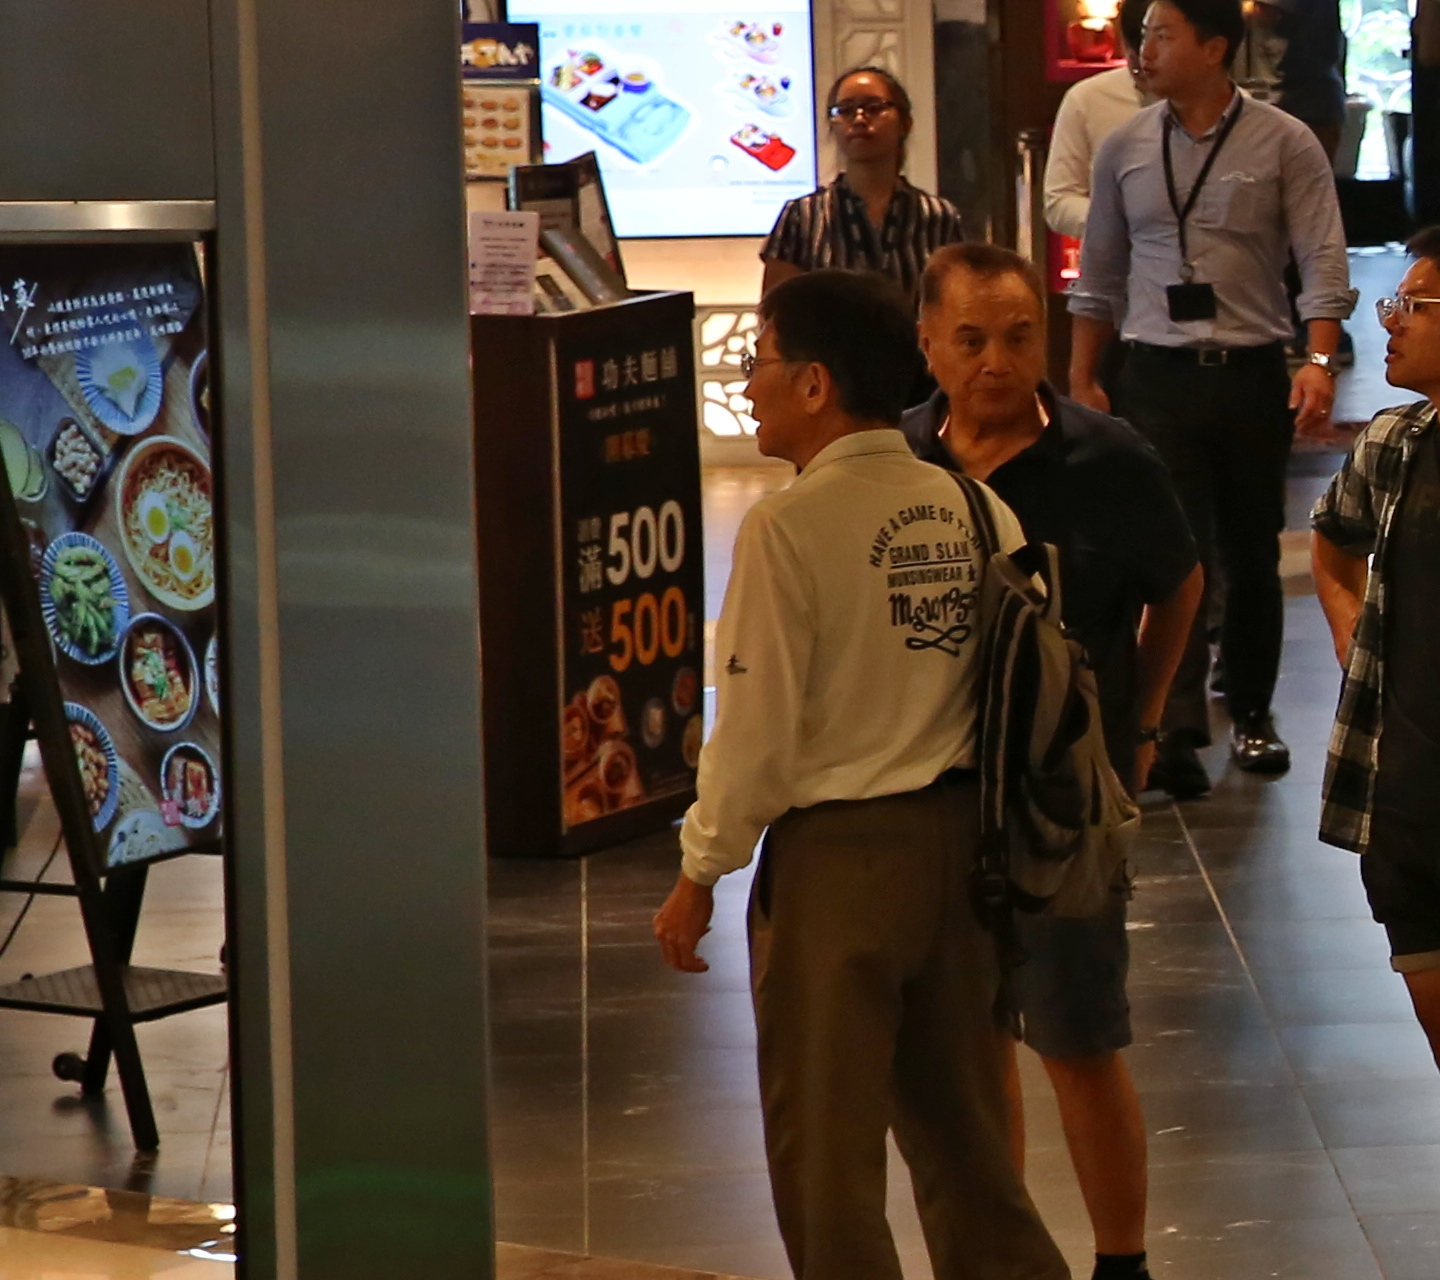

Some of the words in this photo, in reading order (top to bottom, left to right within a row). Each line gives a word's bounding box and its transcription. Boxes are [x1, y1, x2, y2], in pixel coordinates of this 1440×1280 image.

[606, 499, 685, 586] 500
[869, 526, 894, 568] HAVE
[898, 505, 936, 526] GAME
[939, 507, 954, 525] OF
[889, 544, 930, 564] GRAND
[935, 540, 969, 559] SLAM
[609, 585, 687, 672] 500
